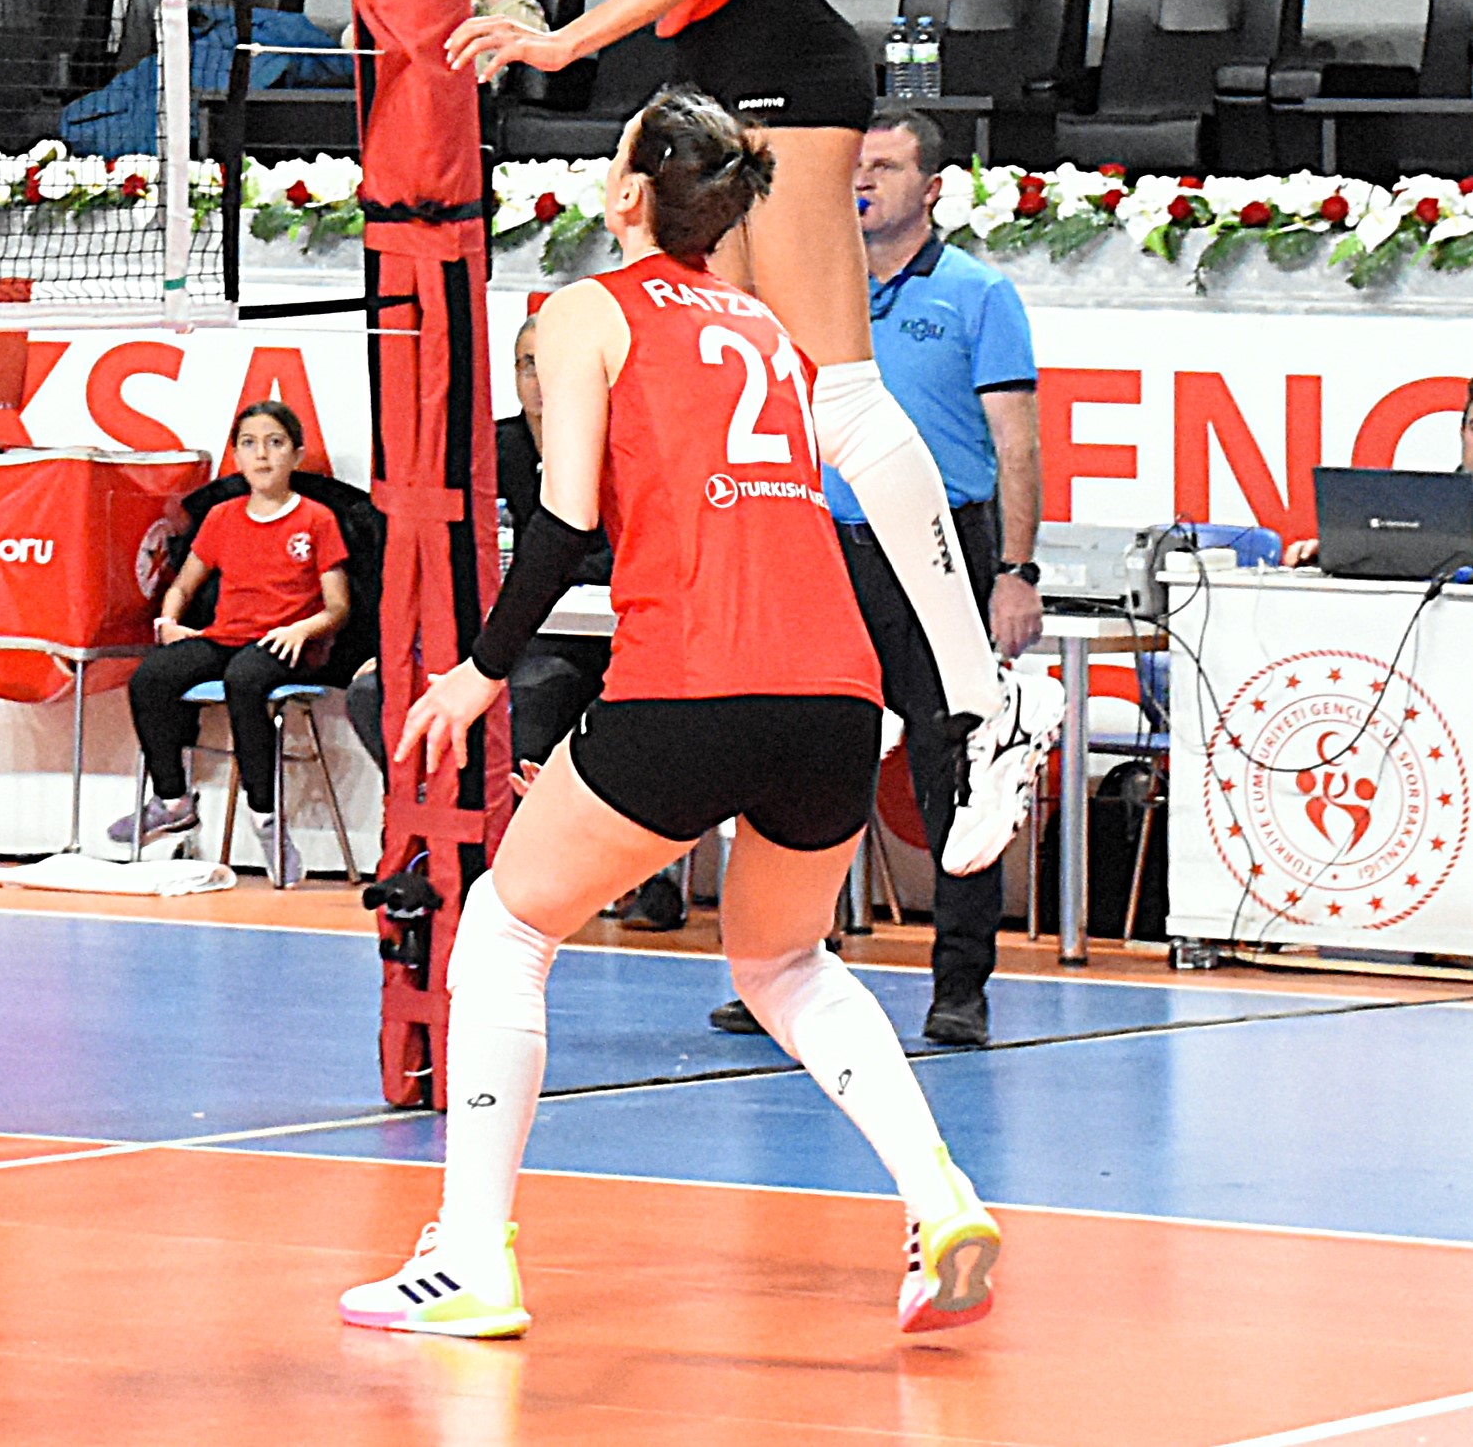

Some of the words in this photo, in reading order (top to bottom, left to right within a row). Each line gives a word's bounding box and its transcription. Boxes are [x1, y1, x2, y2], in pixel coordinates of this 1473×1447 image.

[699, 325, 817, 471] 21
[738, 481, 807, 500] TURKISH
[1309, 701, 1382, 728] GENÇLK
[1397, 752, 1420, 800] SPOR
